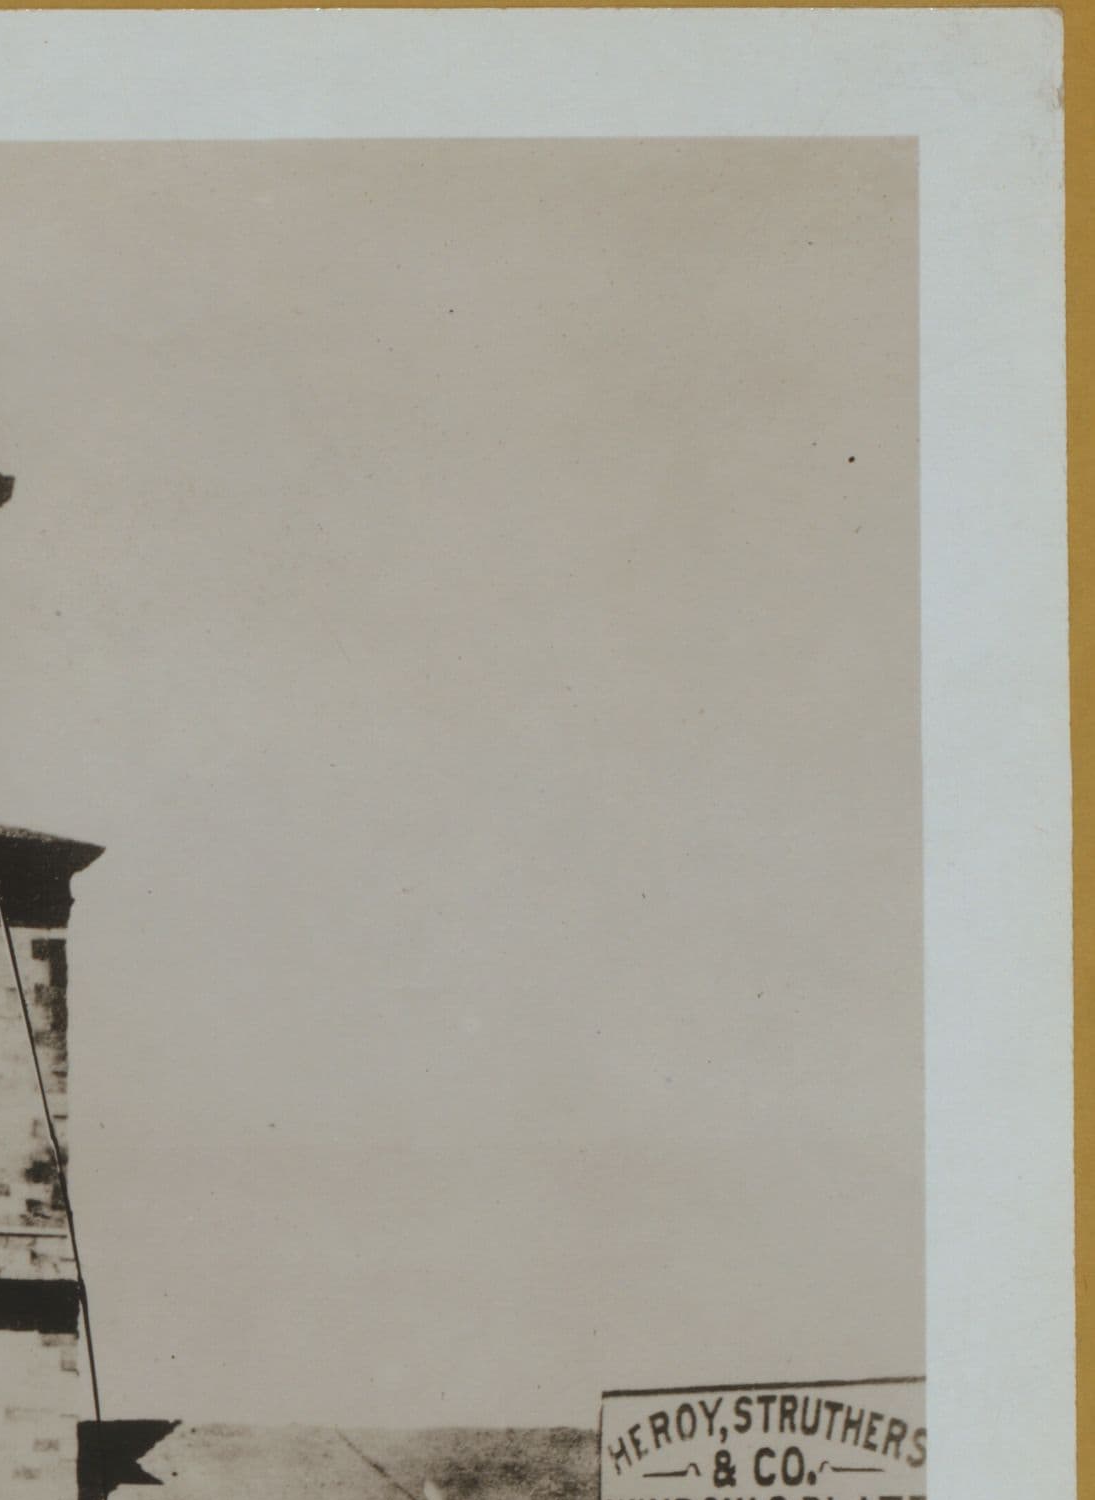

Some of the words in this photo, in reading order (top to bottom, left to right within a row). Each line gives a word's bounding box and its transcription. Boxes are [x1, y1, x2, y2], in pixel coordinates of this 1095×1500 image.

[607, 1397, 728, 1475] HEROY,
[733, 1394, 927, 1467] STRUTHERS
[712, 1449, 737, 1488] &
[753, 1446, 817, 1486] CO.
